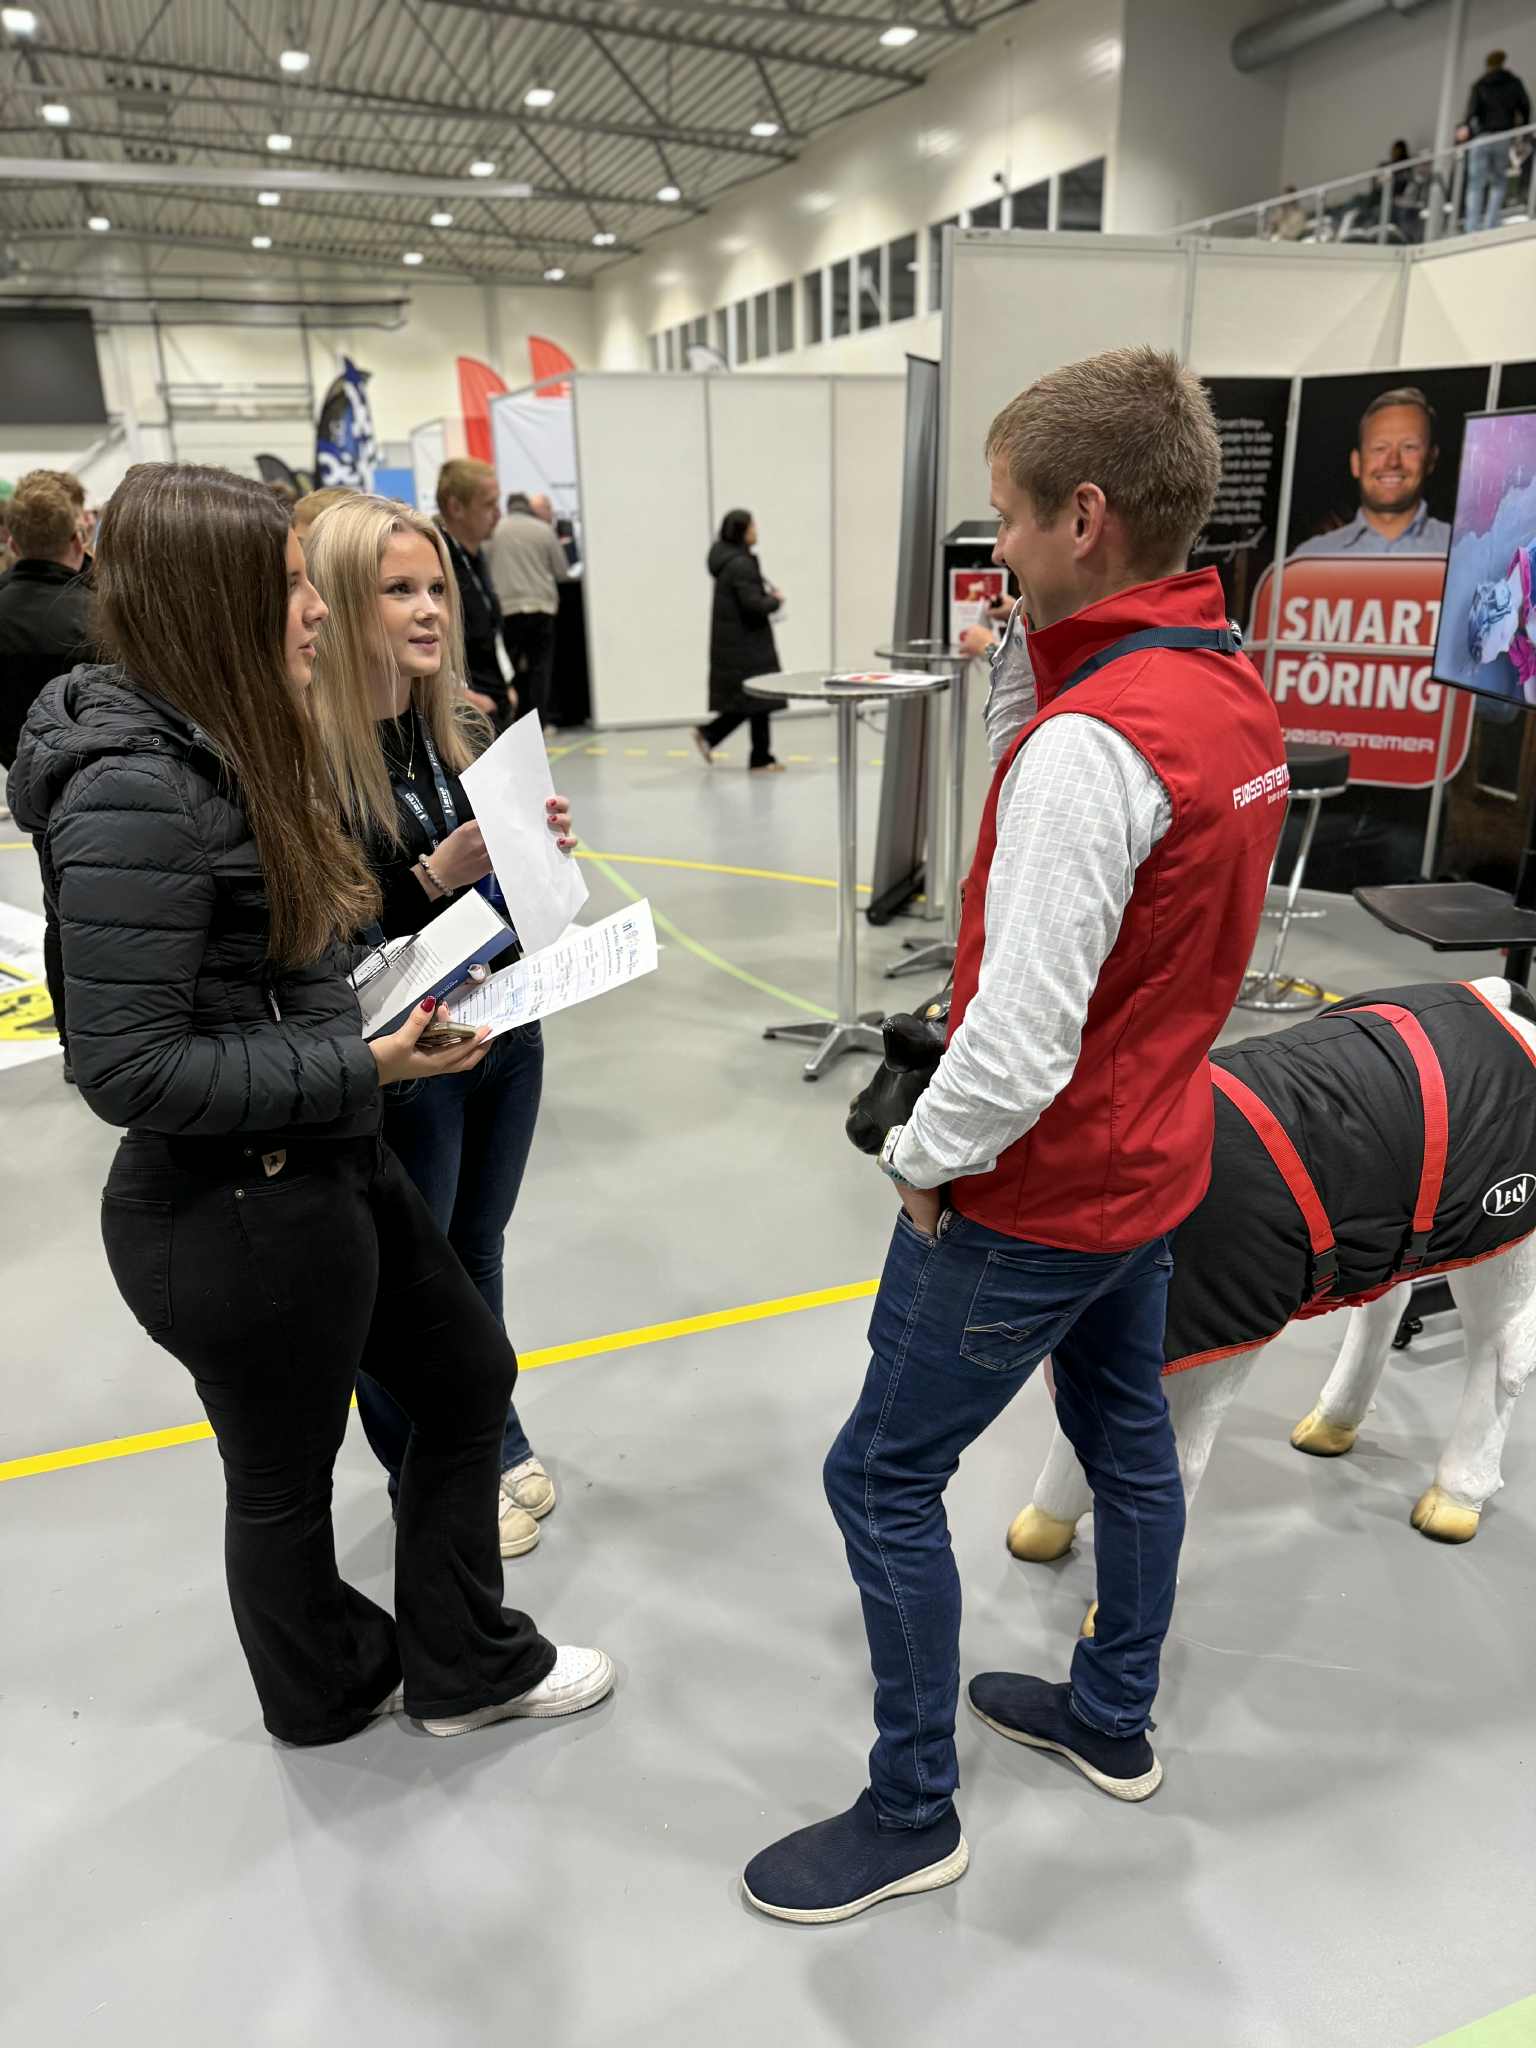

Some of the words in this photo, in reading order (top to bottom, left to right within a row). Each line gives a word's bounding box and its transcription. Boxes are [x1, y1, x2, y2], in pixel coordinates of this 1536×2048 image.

[1281, 596, 1442, 646] SMART
[1274, 652, 1443, 713] FÔRING
[1281, 728, 1434, 752] JØSSYSTEMER
[1494, 1176, 1527, 1214] LELY
